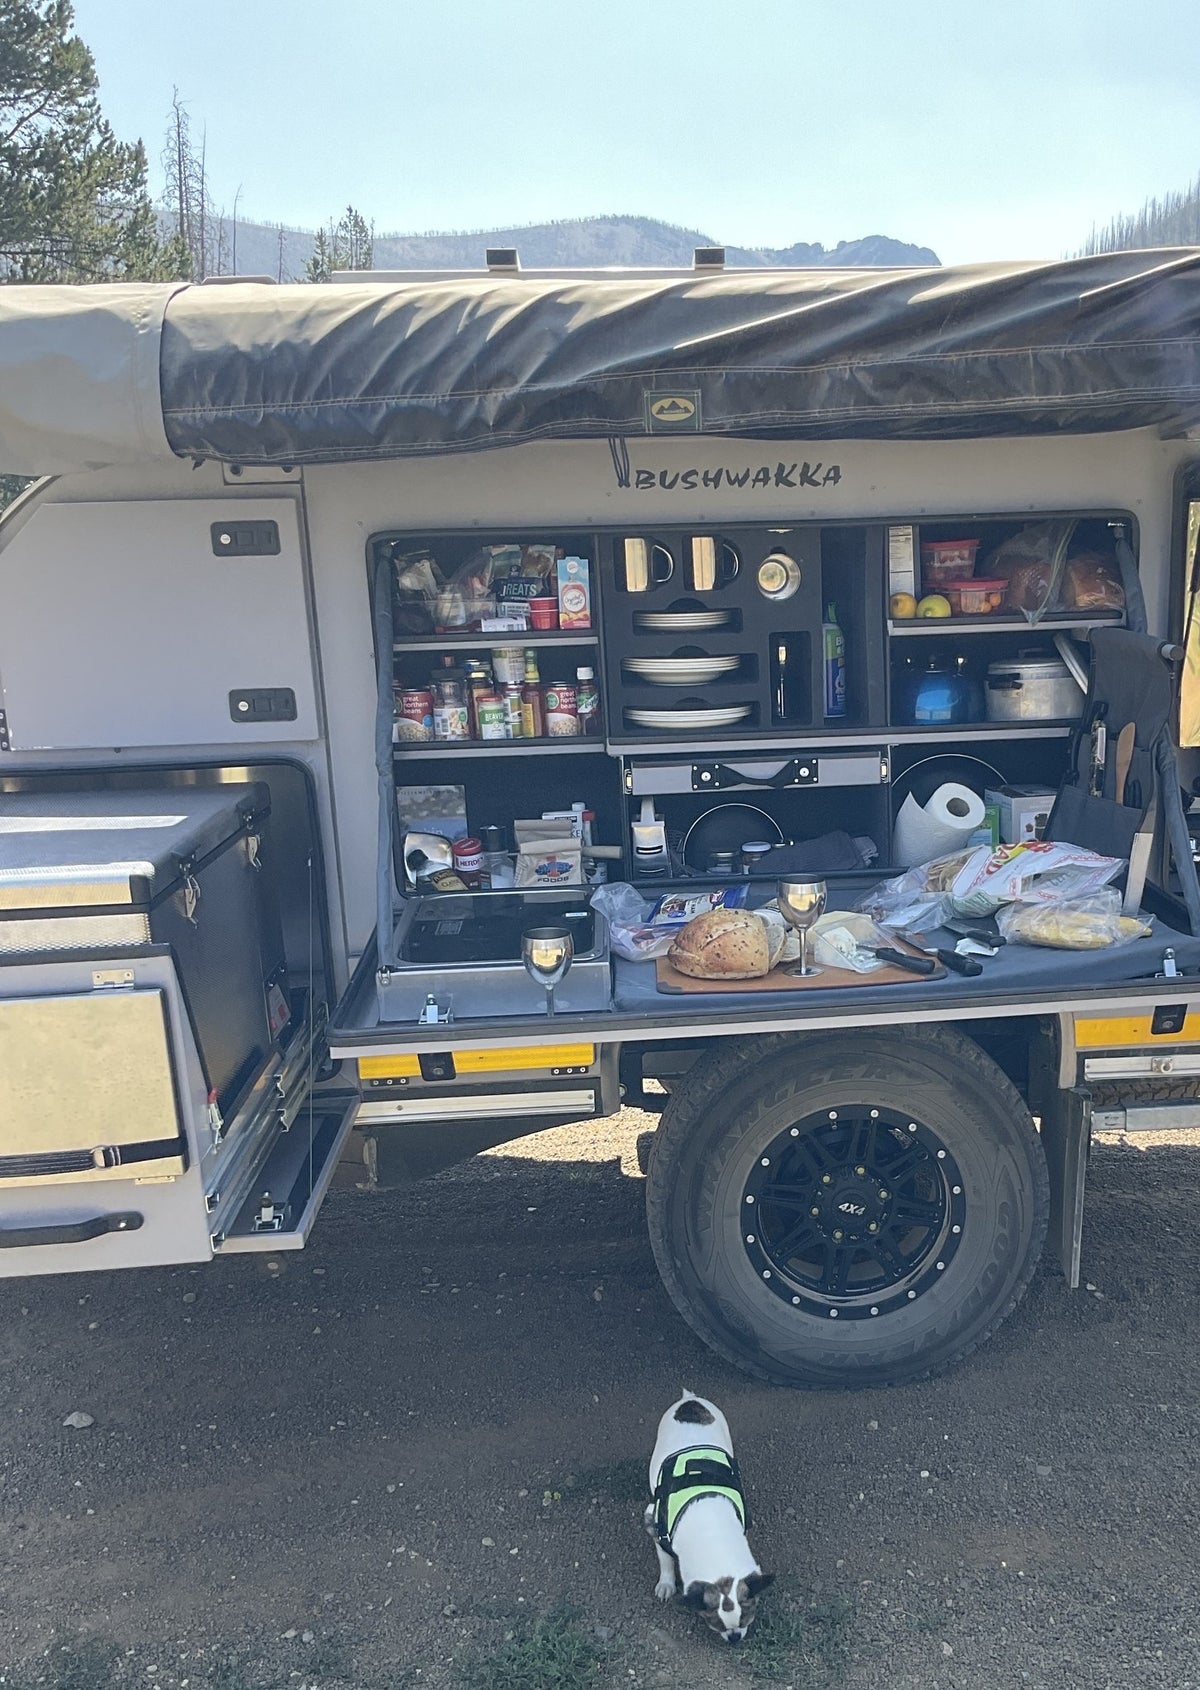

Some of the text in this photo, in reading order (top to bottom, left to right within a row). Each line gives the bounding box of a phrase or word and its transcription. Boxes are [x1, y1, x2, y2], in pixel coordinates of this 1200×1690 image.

[635, 462, 842, 490] BUSHWAKKA
[402, 695, 419, 703] great
[559, 691, 575, 699] great
[484, 712, 504, 722] BEAV
